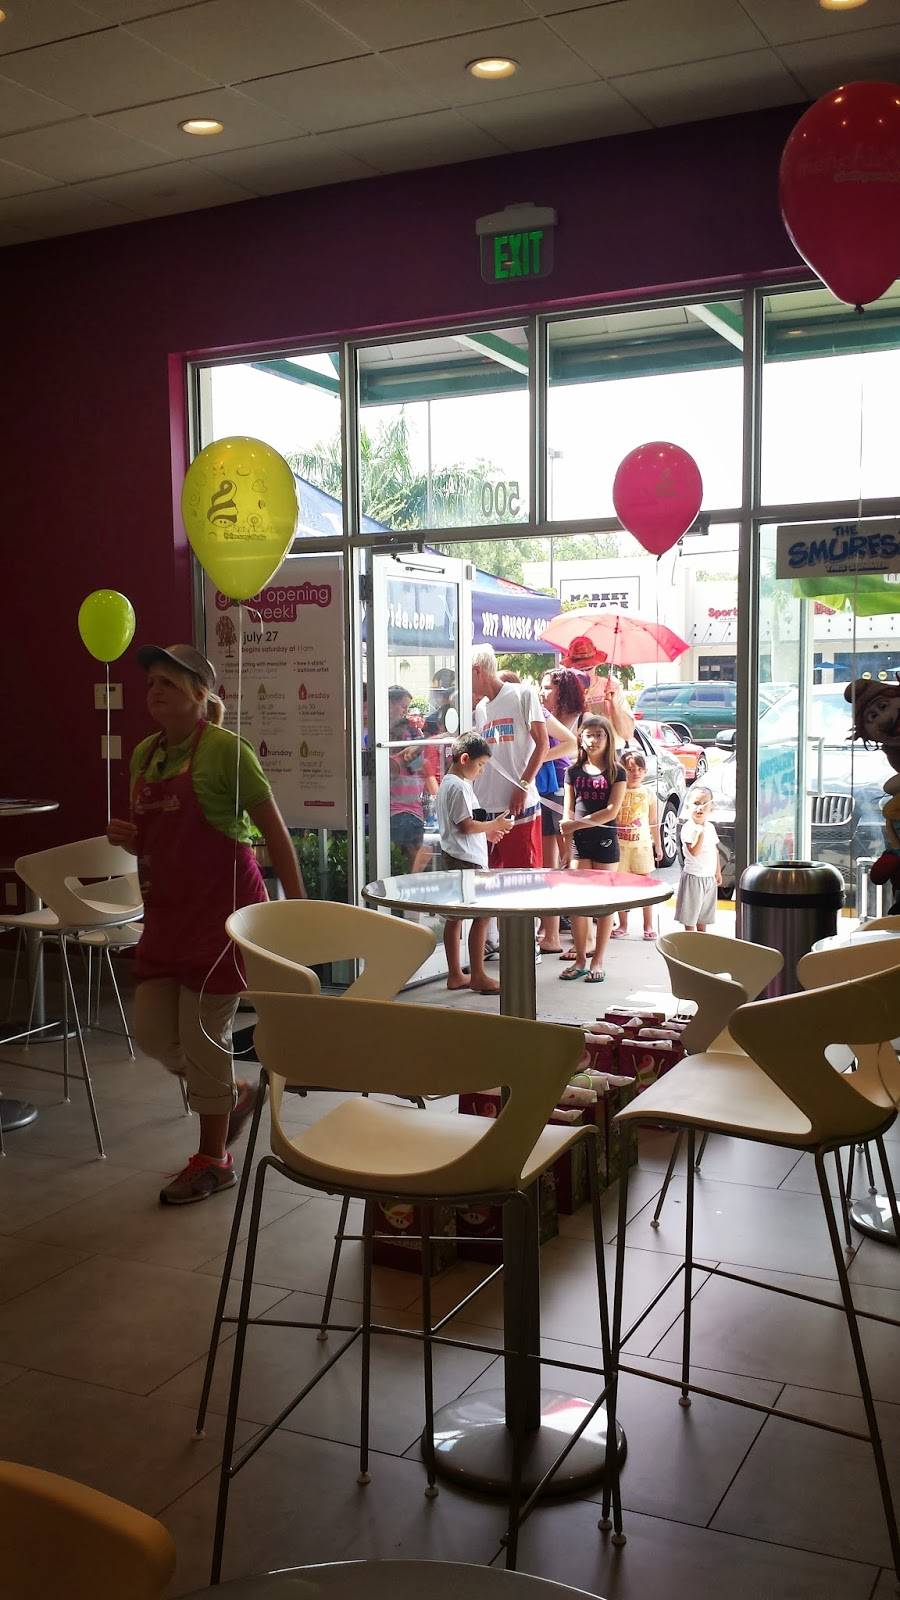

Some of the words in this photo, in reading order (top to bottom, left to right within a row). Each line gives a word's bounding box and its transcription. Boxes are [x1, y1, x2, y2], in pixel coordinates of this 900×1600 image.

[495, 230, 544, 279] EXIT
[832, 525, 858, 536] THE
[787, 533, 900, 569] SMURFS
[266, 586, 330, 605] opening
[570, 592, 629, 602] MARKET
[251, 604, 294, 619] week!
[708, 607, 738, 619] Sport
[481, 612, 499, 638] HIT
[502, 614, 532, 641] MUSIC
[534, 617, 551, 641] NO
[242, 631, 263, 645] july
[265, 631, 279, 642] 27
